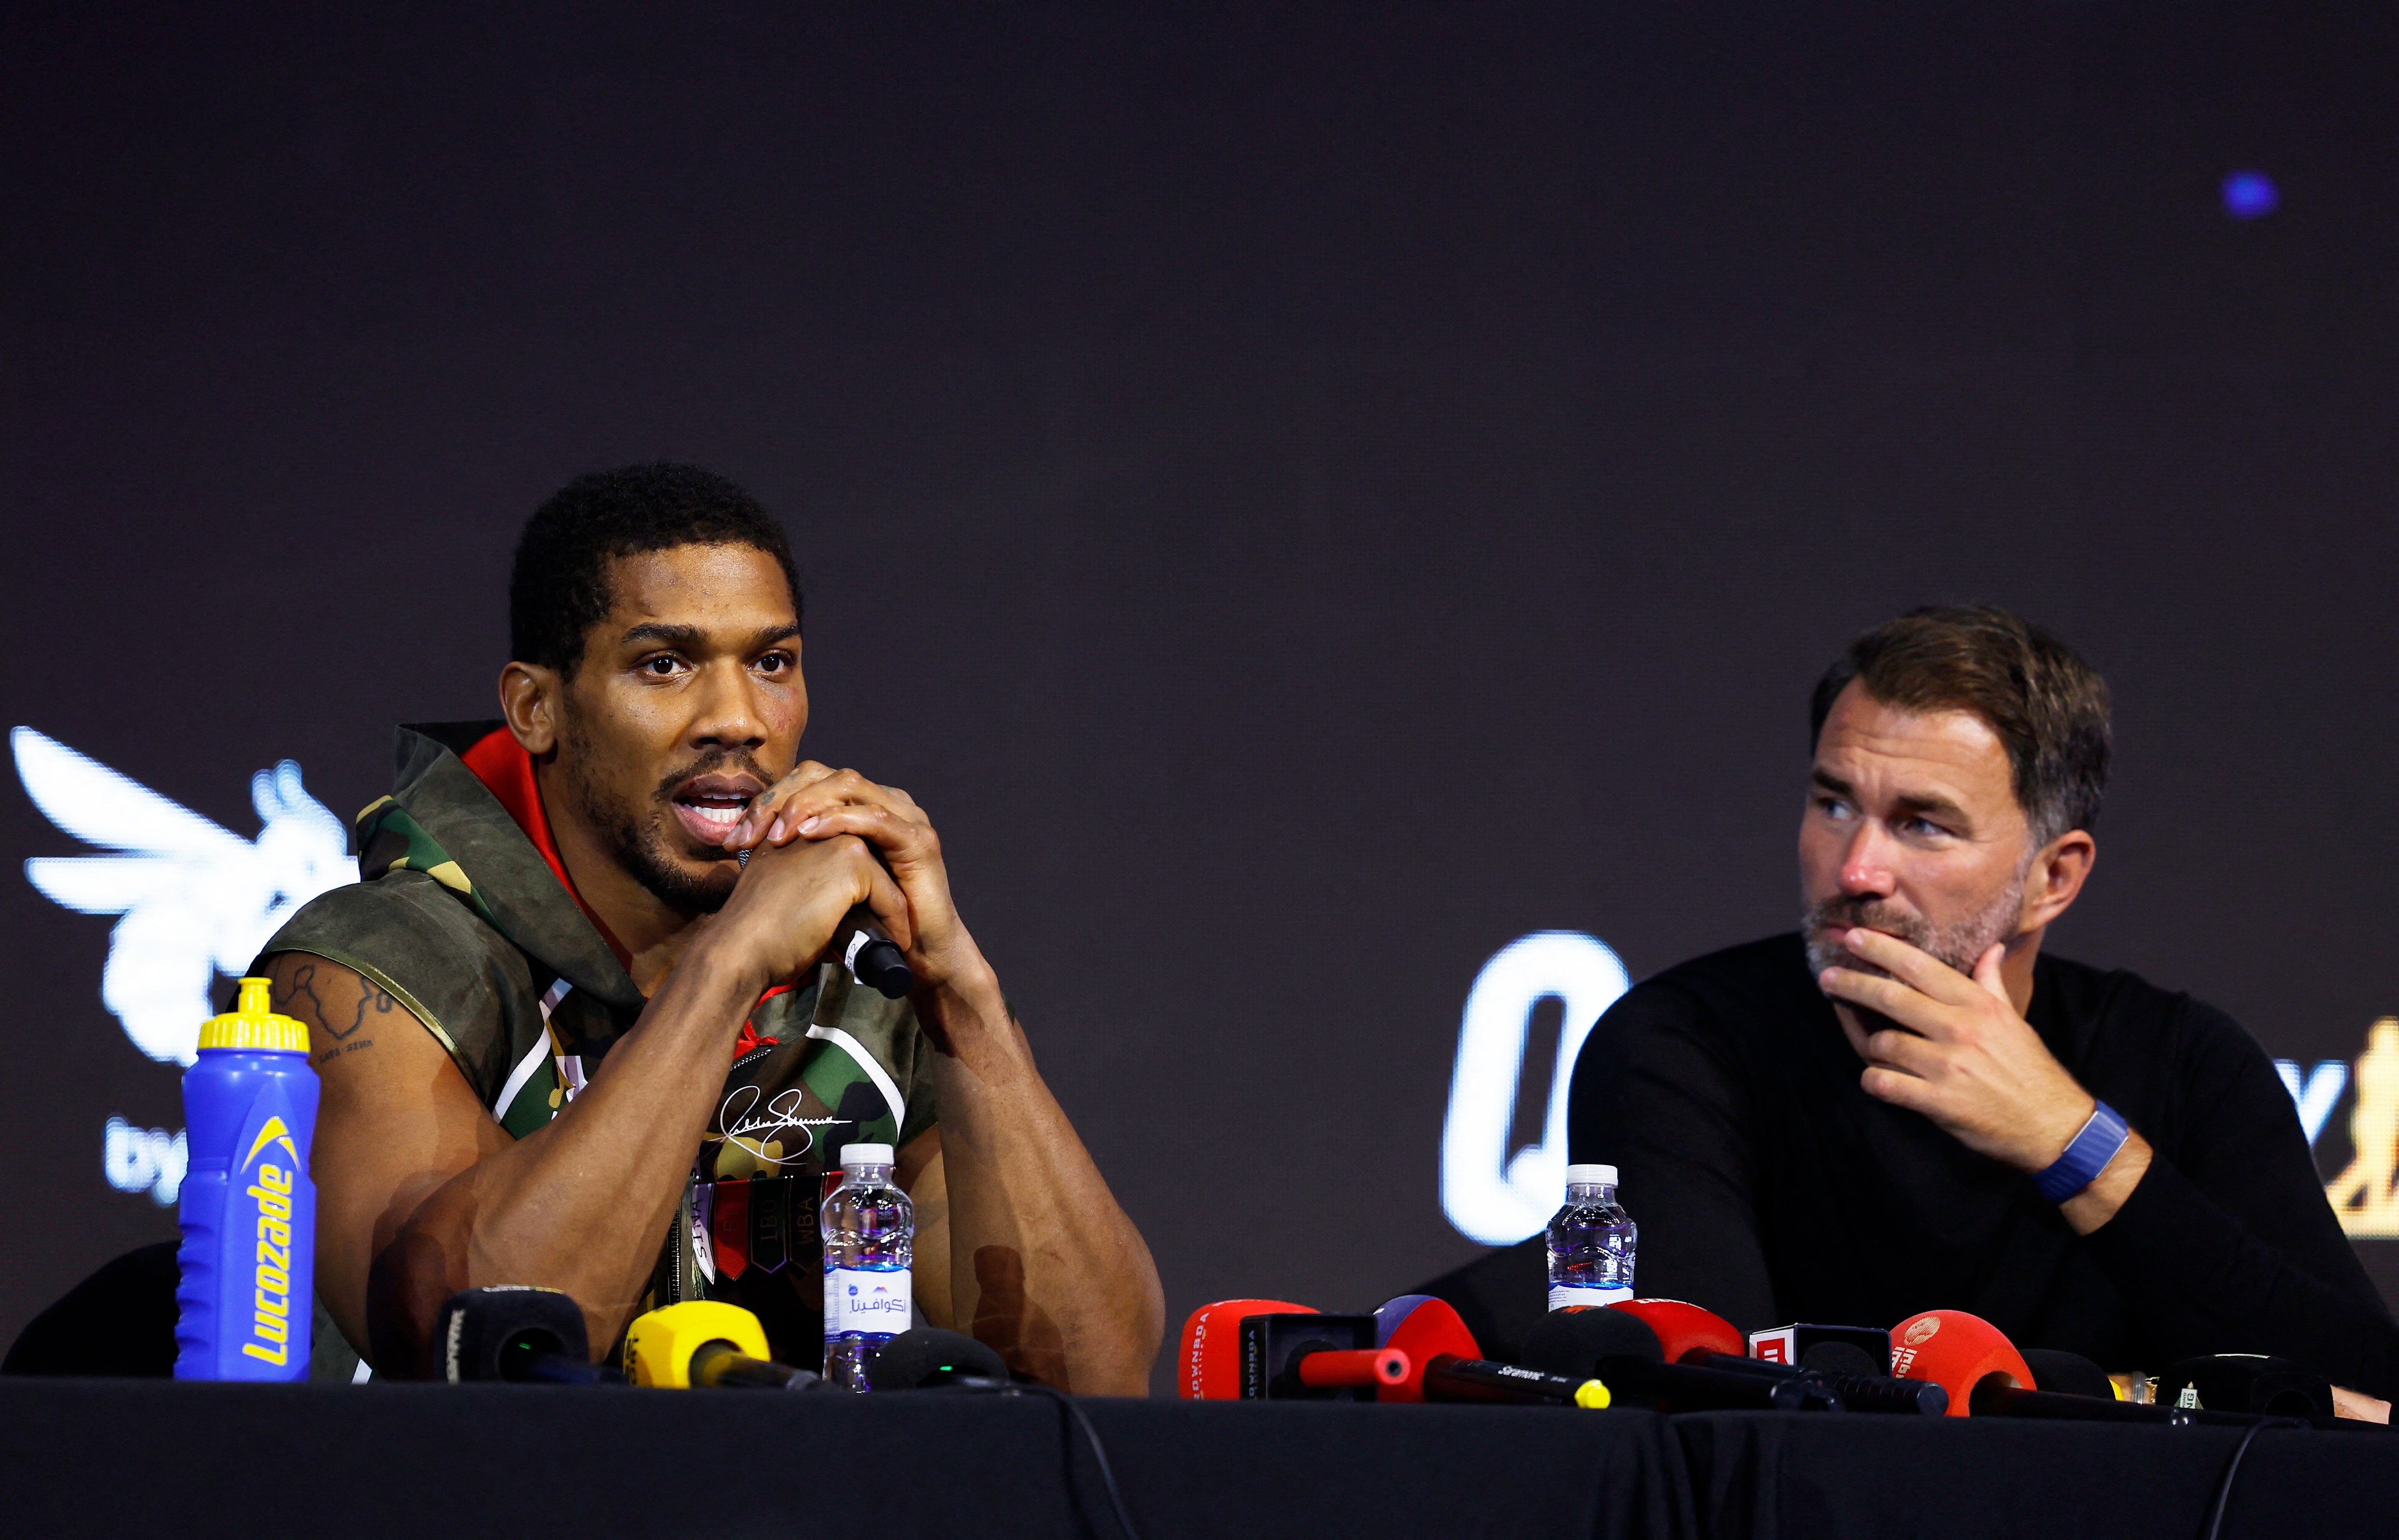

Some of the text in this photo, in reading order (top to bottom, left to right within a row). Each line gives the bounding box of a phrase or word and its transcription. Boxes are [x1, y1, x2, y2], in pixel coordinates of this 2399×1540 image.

[760, 1199, 778, 1243] IBO
[797, 1196, 815, 1245] WBA
[243, 1165, 292, 1366] Lucozade
